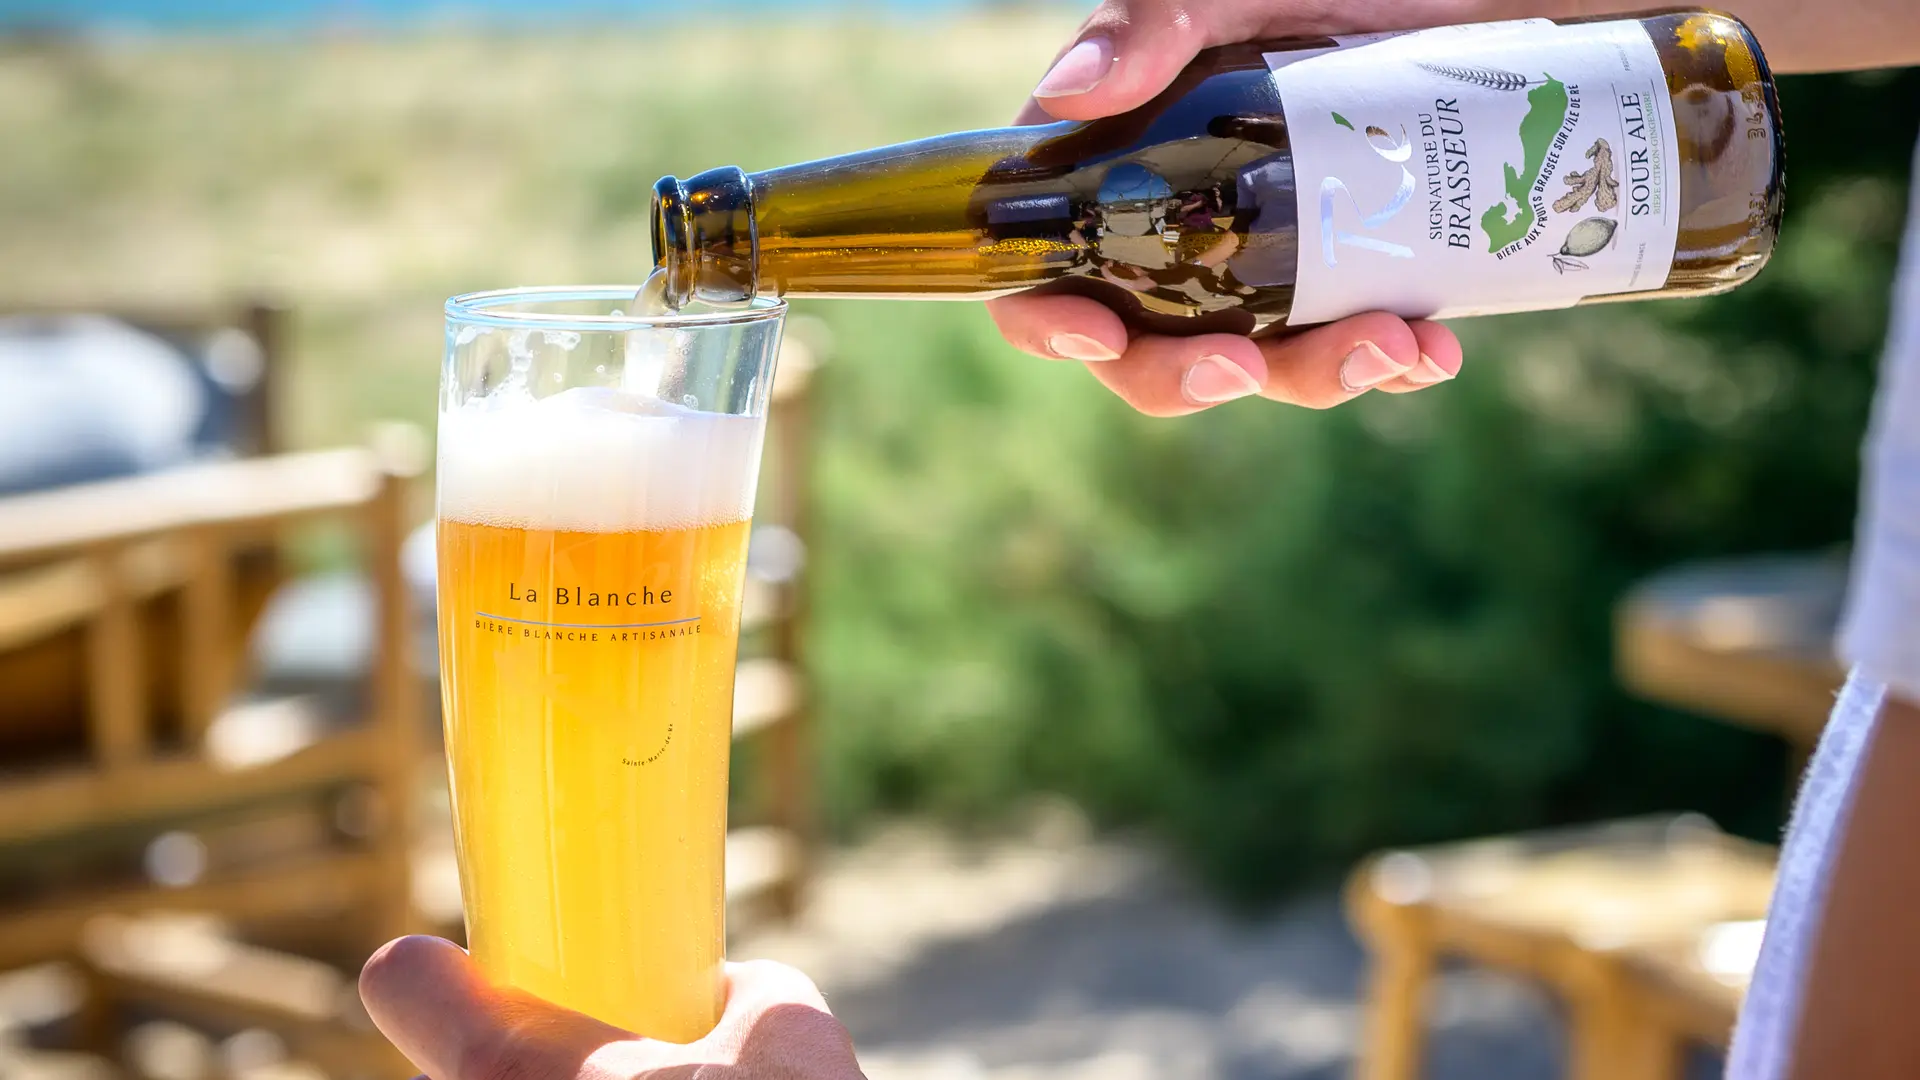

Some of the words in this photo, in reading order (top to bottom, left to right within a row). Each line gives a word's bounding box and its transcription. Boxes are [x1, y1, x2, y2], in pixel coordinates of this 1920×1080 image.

[1567, 84, 1580, 95] RÉ
[1570, 98, 1581, 109] DE
[1620, 92, 1645, 140] ALE
[1418, 113, 1436, 137] DU
[1554, 132, 1568, 151] SUR
[1435, 98, 1471, 249] BRASSEUR
[1534, 152, 1560, 193] BRASSÉE
[1630, 147, 1651, 216] SOUR
[1424, 140, 1443, 240] SIGNATURE
[1651, 187, 1662, 215] BIÈRE
[1532, 196, 1548, 228] FRUITS
[1524, 228, 1542, 246] AUX
[1496, 242, 1523, 261] BIÈRE
[509, 582, 537, 603] La
[555, 585, 673, 607] Blanche
[475, 619, 514, 636] BIÈRE
[524, 629, 599, 642] BLANCHE
[610, 624, 702, 642] ARTISANALE
